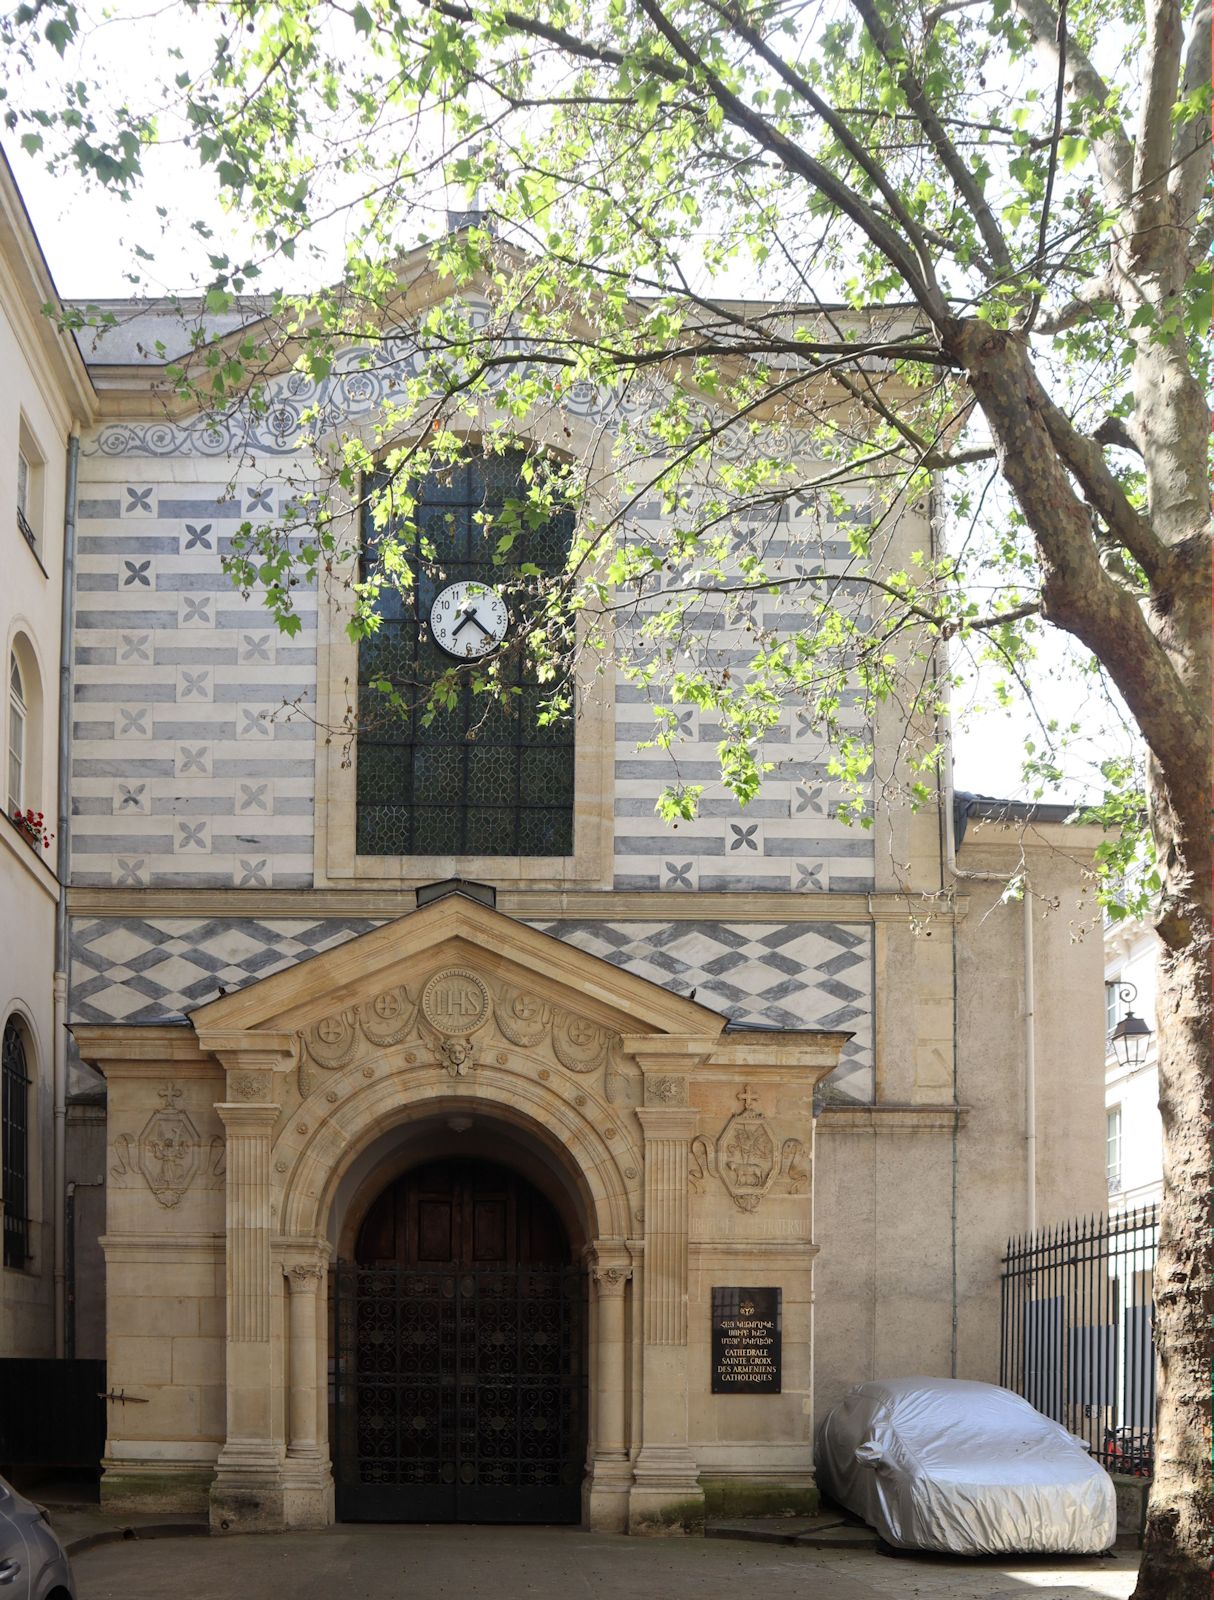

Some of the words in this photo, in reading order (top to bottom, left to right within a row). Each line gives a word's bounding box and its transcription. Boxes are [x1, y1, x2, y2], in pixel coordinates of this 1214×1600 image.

[452, 591, 459, 600] 11
[441, 601, 450, 610] 10
[491, 601, 498, 611] 2
[436, 613, 442, 623] 9
[496, 615, 502, 625] 3
[440, 628, 446, 638] 8
[452, 638, 458, 648] 7
[465, 642, 472, 652] 6
[480, 638, 486, 648] 5
[435, 990, 480, 1016] IHS
[722, 1357, 747, 1365] SAINTE
[750, 1357, 772, 1365] CROIX
[721, 1374, 773, 1383] CATHOLIQUES
